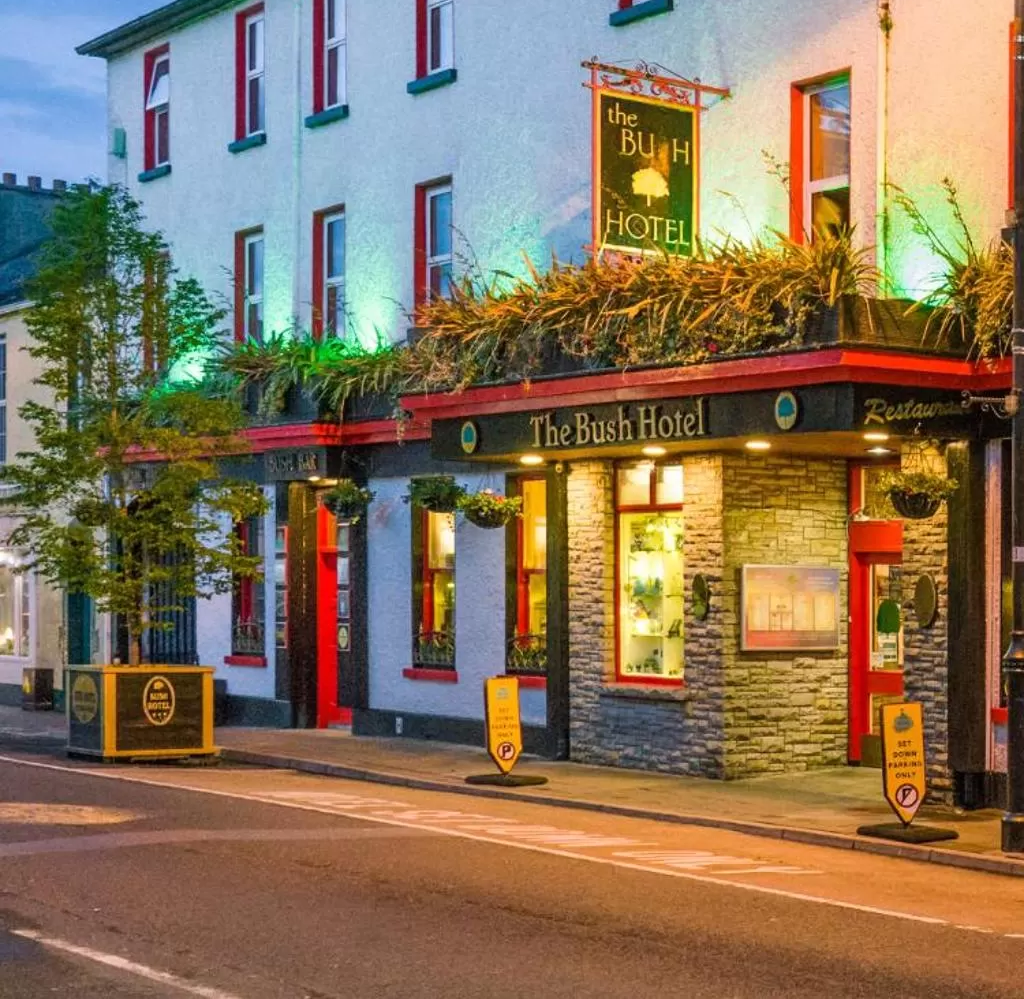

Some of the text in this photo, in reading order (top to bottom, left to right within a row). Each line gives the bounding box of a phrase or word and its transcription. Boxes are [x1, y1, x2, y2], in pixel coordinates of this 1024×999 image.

[608, 103, 638, 127] the
[620, 129, 689, 165] BUH
[606, 209, 690, 245] HOTEL
[529, 397, 705, 447] The Bush Hotel
[892, 751, 917, 759] DOWN
[897, 740, 912, 748] SET
